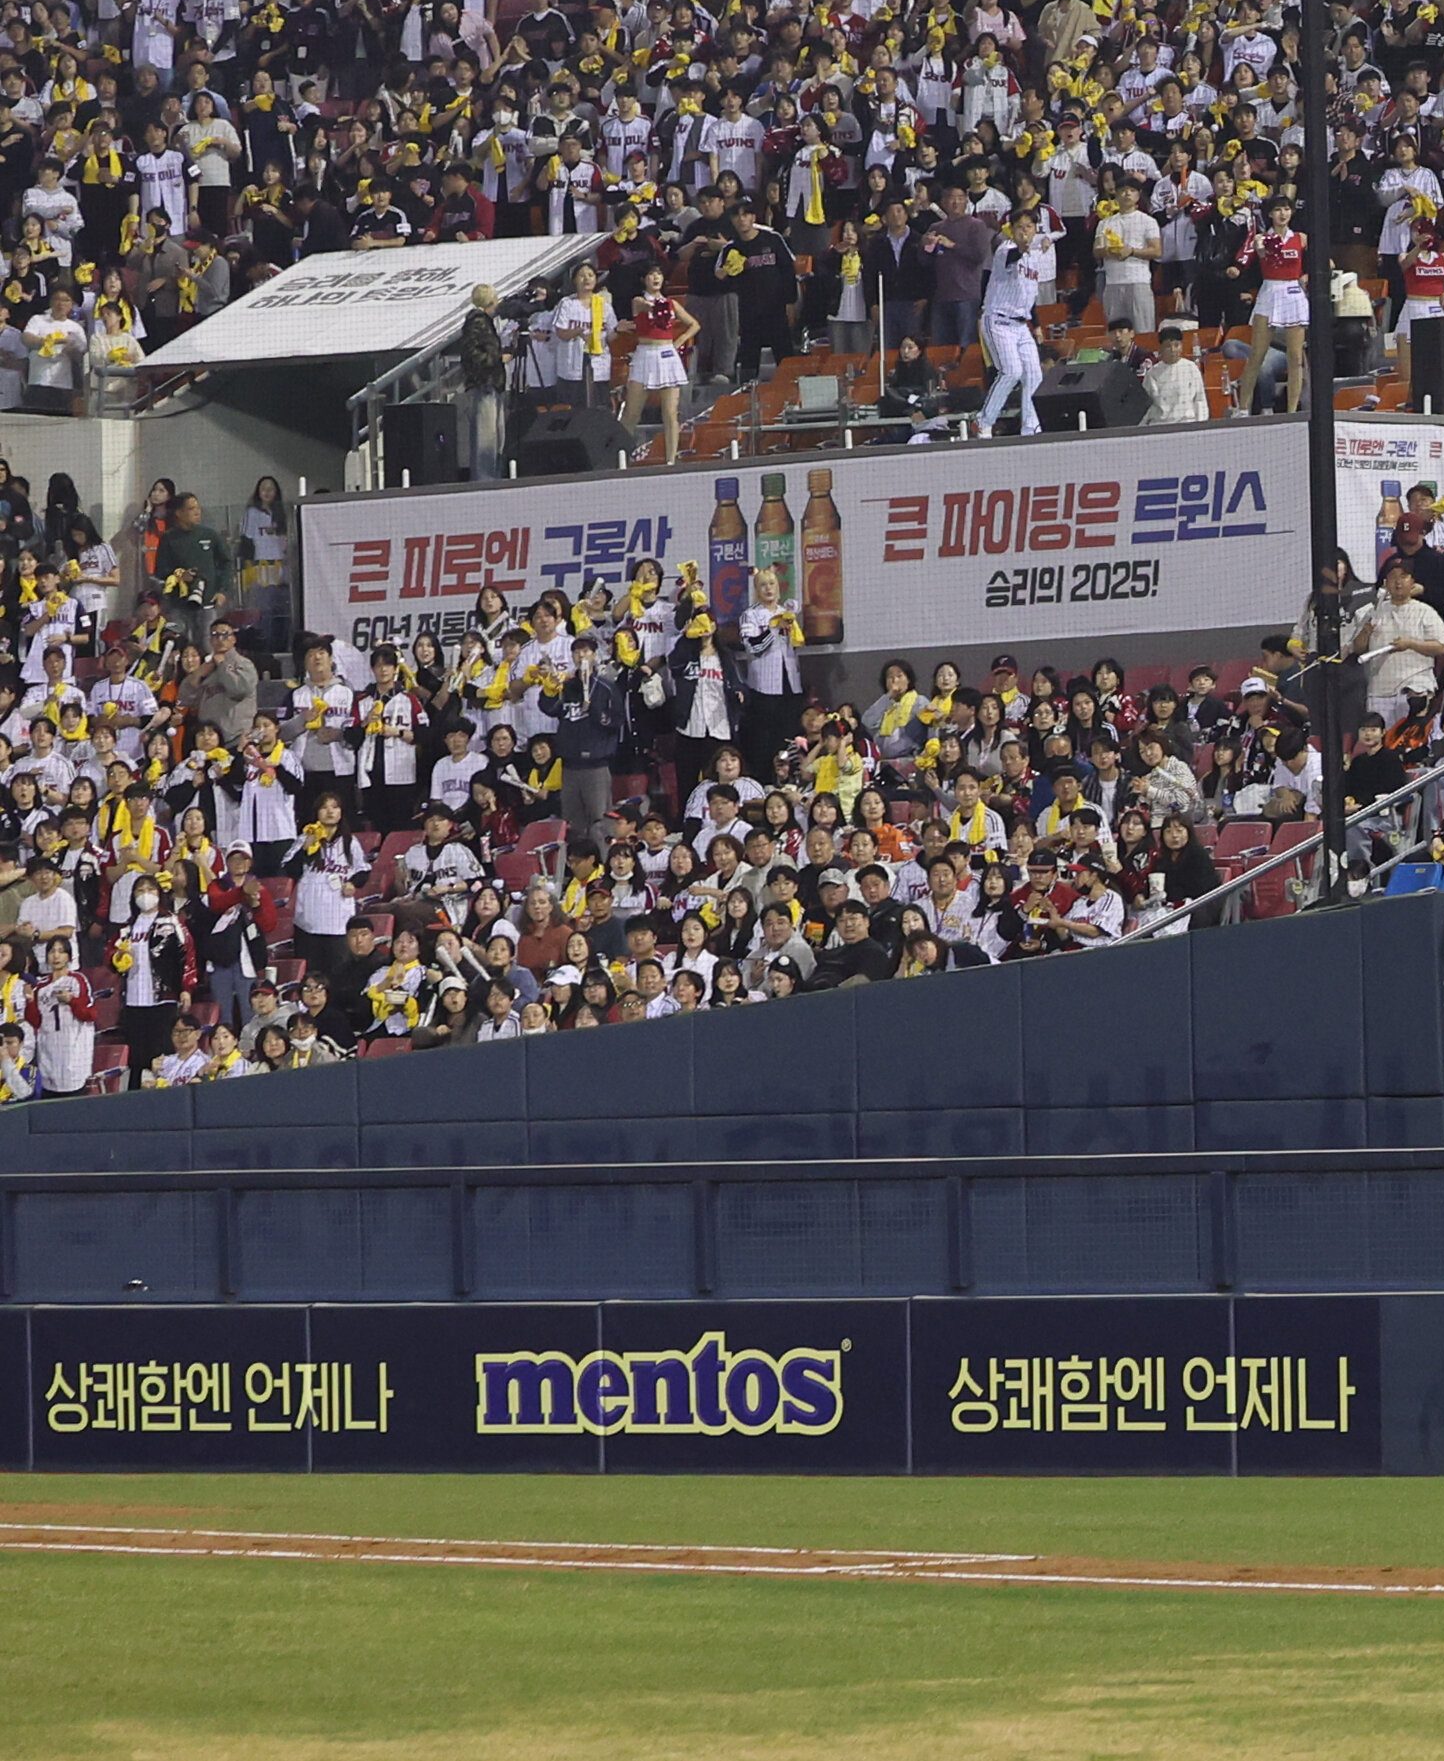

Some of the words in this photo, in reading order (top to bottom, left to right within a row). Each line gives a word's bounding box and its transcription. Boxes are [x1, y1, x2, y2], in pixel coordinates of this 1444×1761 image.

[884, 497, 928, 562] 큰
[938, 481, 1120, 559] 파이팅은
[1132, 470, 1268, 544] 트윈스
[349, 538, 391, 603] 큰
[401, 527, 530, 602] 피로엔
[985, 564, 1063, 608] 승리의
[1071, 559, 1160, 603] 2025!
[49, 1005, 61, 1031] 1
[44, 1359, 231, 1433] 상쾌함엔
[244, 1359, 393, 1434] 언제나
[475, 1331, 844, 1437] mentos
[948, 1354, 1167, 1433] 상쾌함엔
[1182, 1355, 1356, 1432] 언제나
